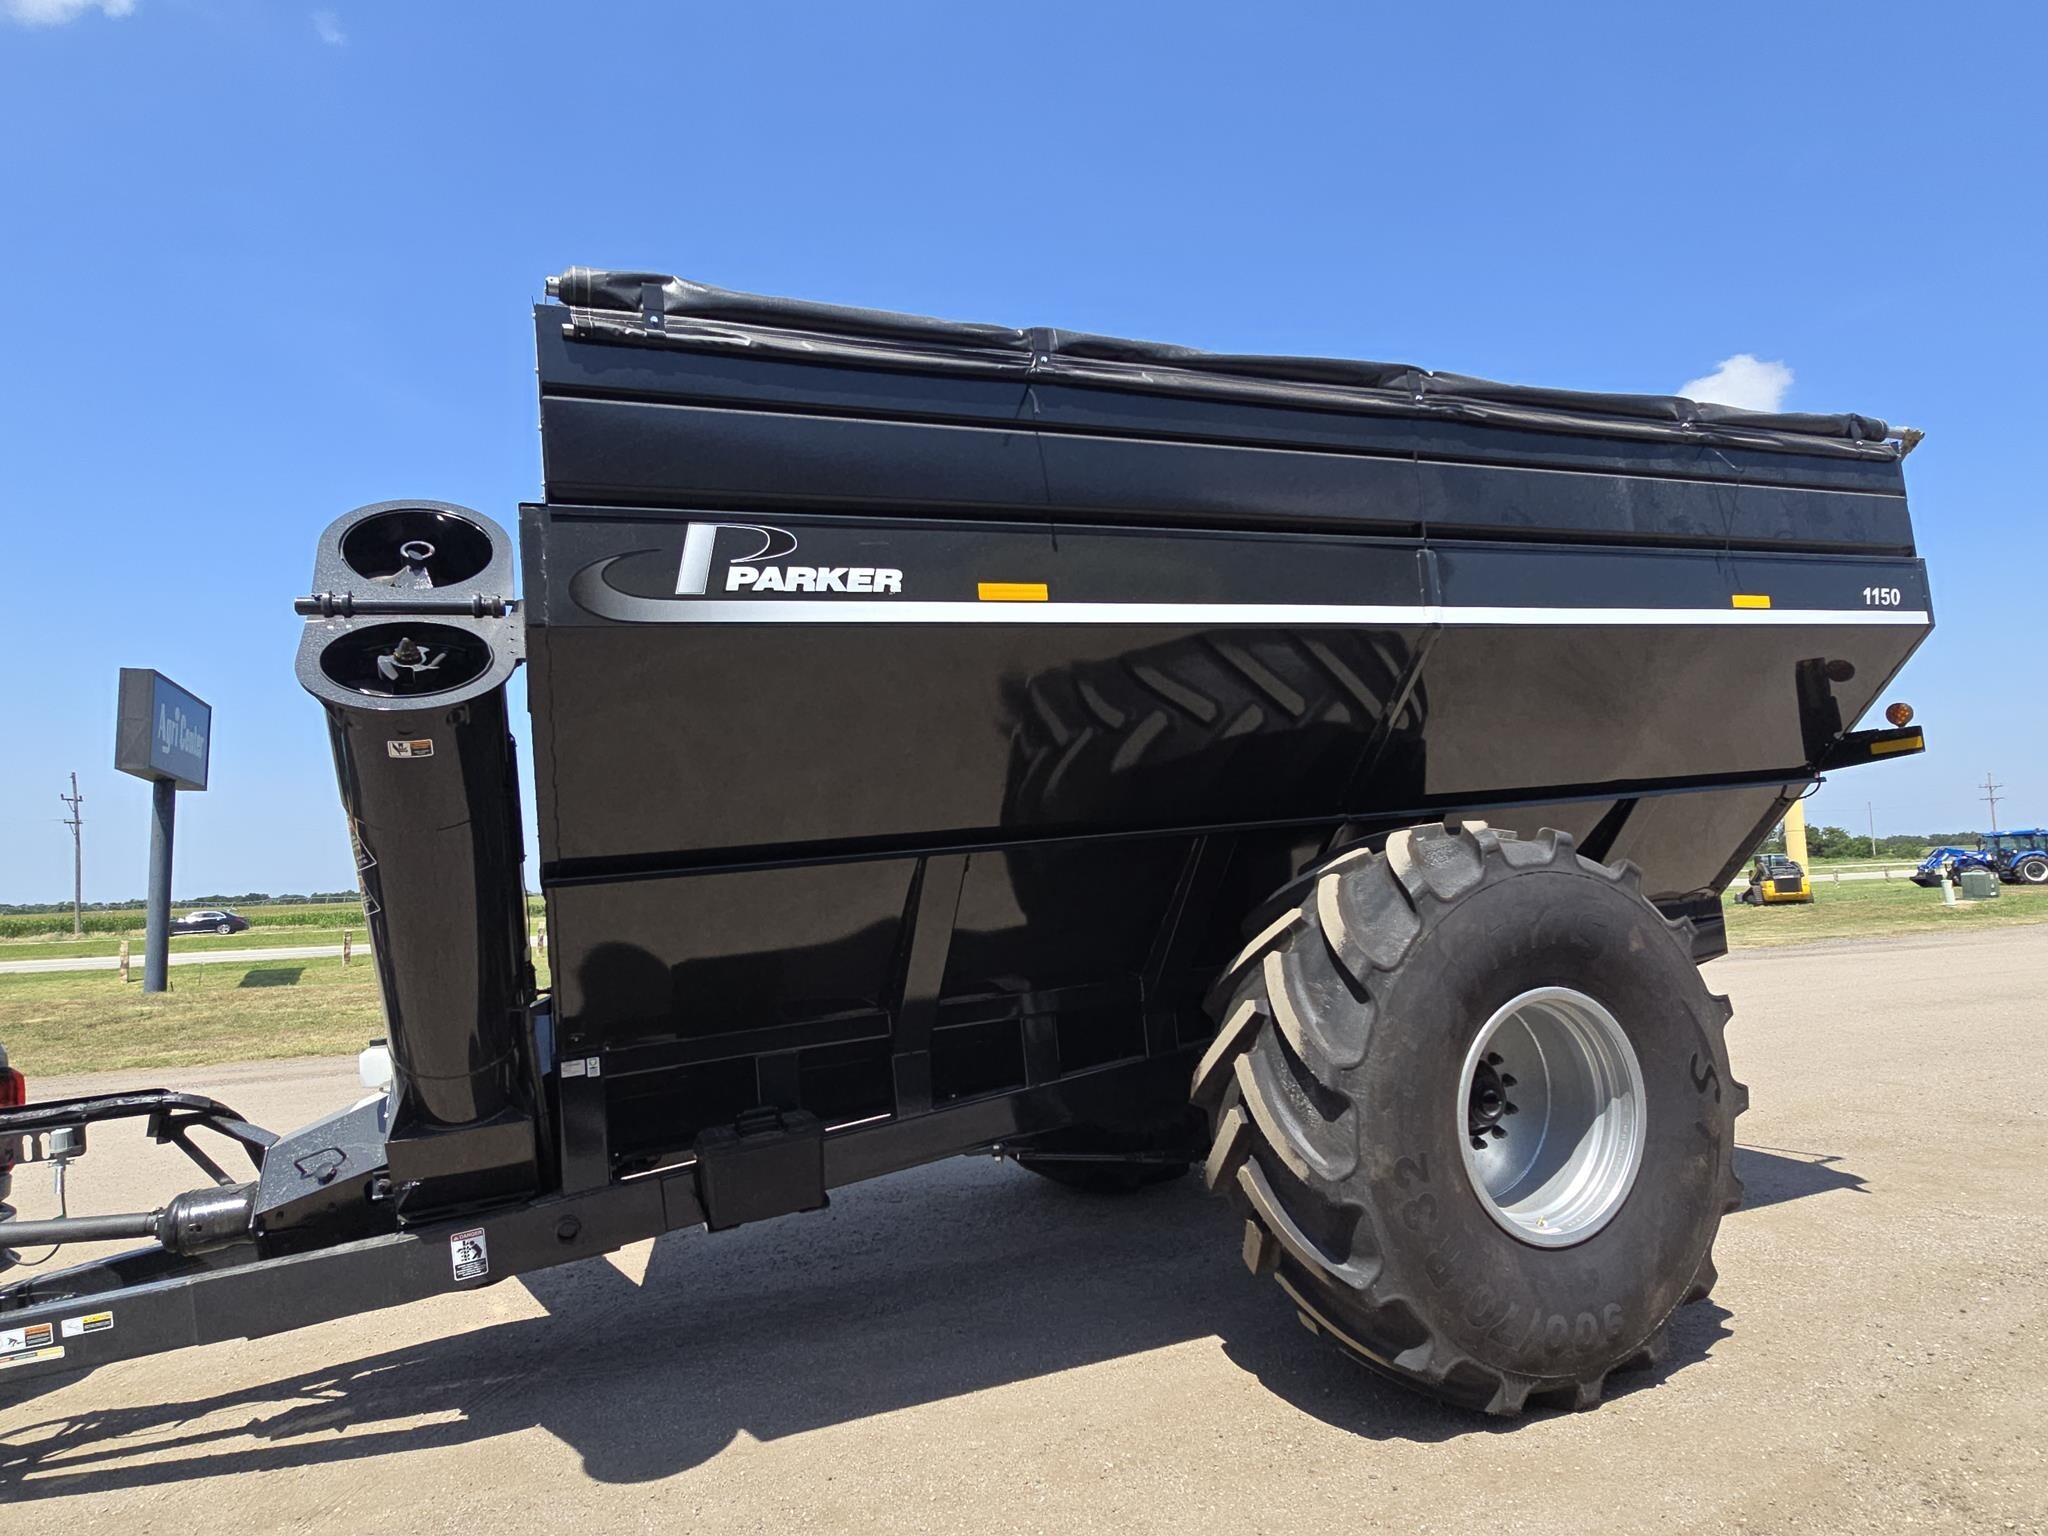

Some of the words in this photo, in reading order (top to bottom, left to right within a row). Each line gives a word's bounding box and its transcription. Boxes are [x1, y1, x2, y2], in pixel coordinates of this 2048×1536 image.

[726, 566, 903, 593] PARKER
[1863, 587, 1901, 605] 1150
[158, 703, 180, 754] Agri
[180, 715, 204, 759] Center
[460, 1230, 482, 1239] DANGER
